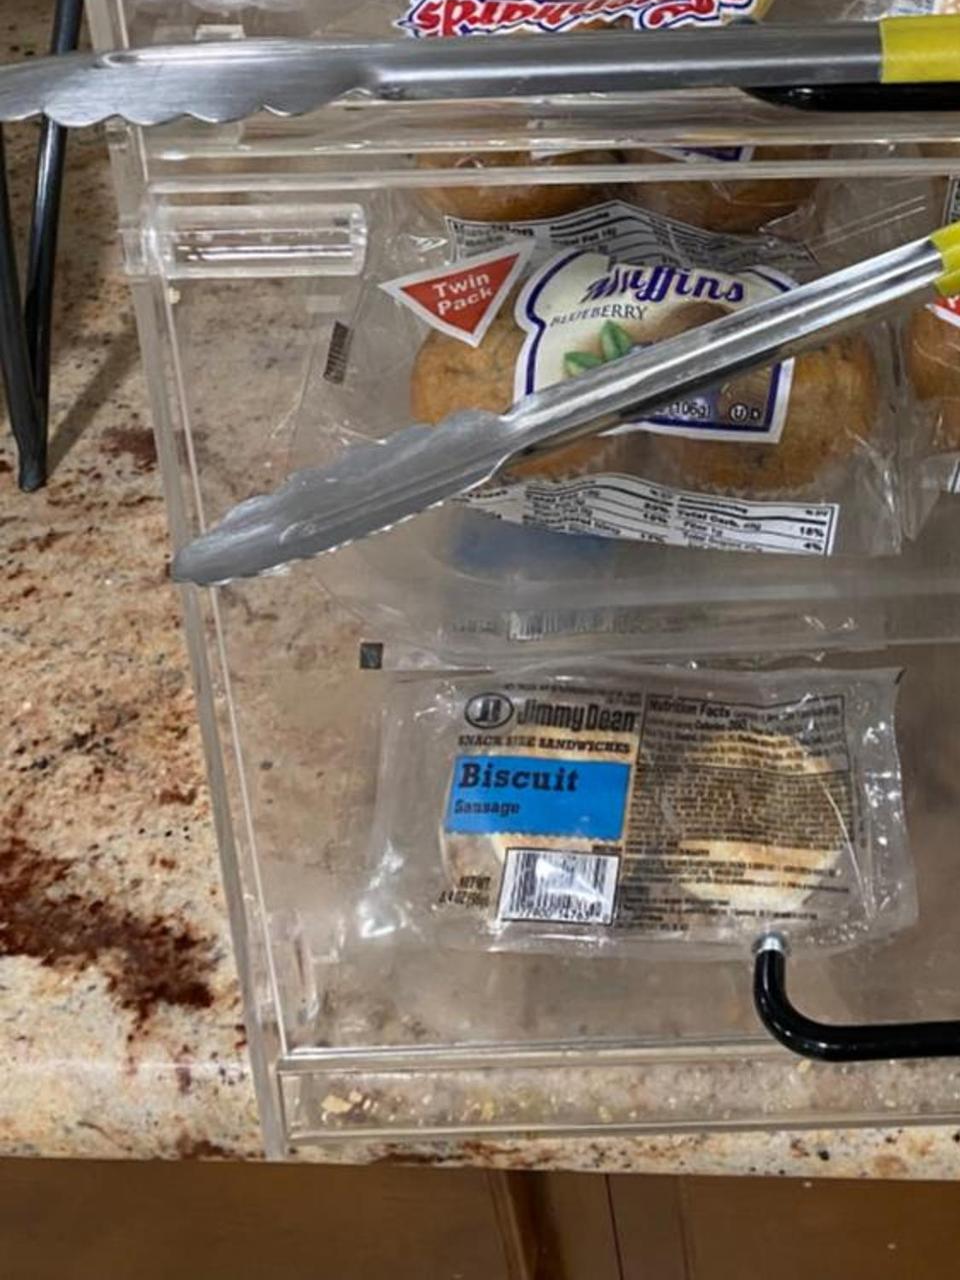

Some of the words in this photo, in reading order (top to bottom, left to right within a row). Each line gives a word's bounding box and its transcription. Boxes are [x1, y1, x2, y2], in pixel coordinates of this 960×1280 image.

[432, 273, 491, 298] Twin
[581, 265, 744, 303] Muffins
[437, 287, 494, 316] Pack
[550, 303, 648, 328] BLUEBERRY
[678, 509, 709, 522] Total
[516, 698, 585, 732] Jimmy
[586, 703, 637, 733] Dean
[538, 735, 631, 755] SANDWICHES
[458, 762, 580, 793] Biscuit
[454, 798, 521, 817] Sausage
